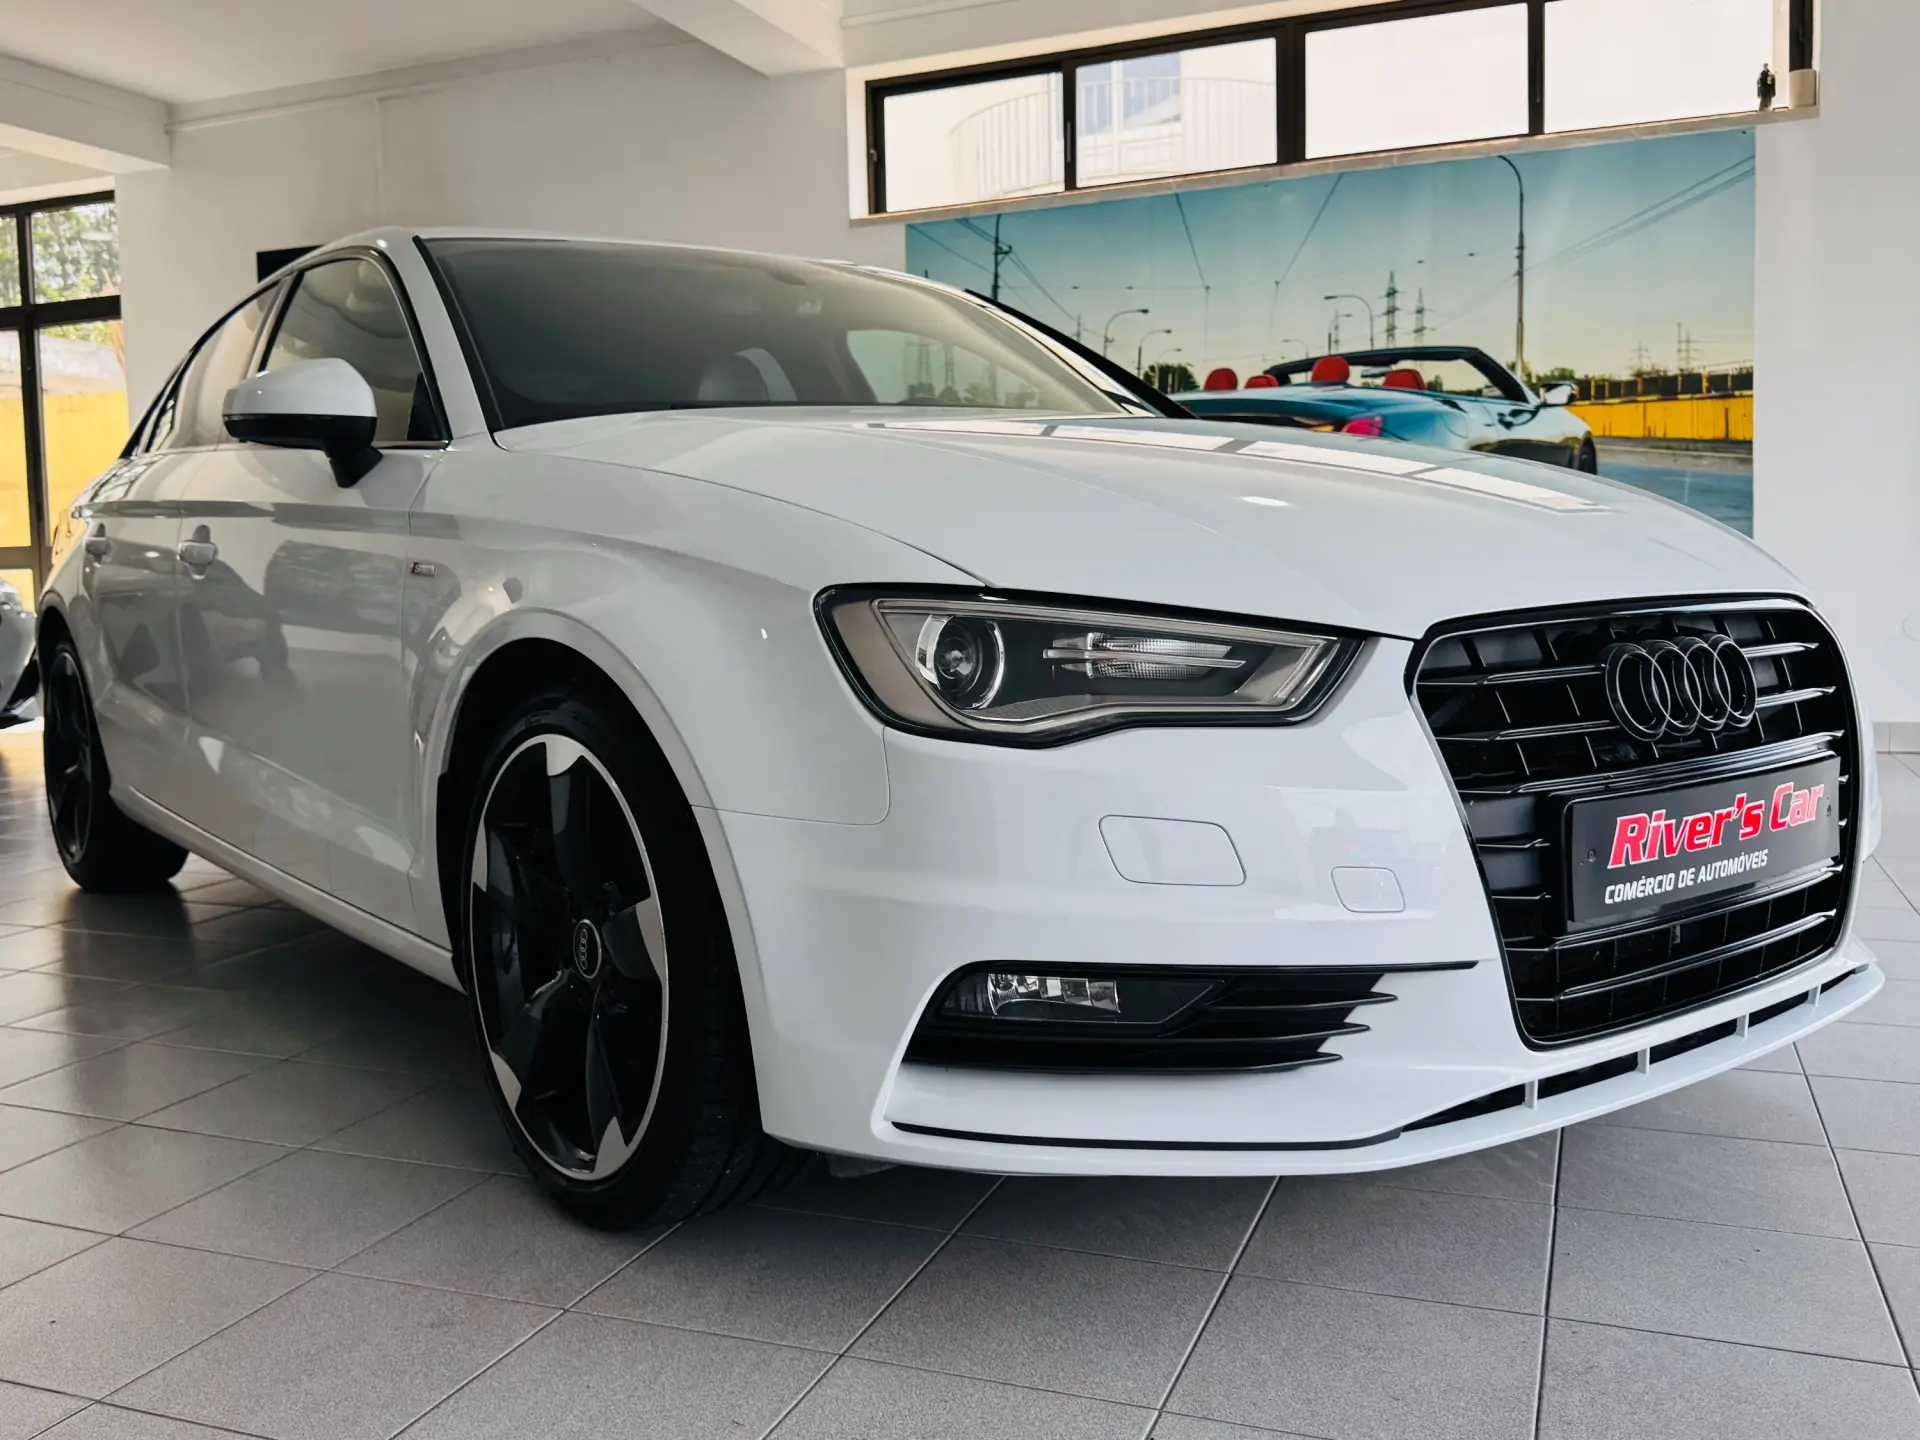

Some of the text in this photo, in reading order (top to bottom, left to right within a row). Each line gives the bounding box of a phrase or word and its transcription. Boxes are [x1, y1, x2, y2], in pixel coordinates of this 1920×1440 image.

[1607, 782, 1824, 869] River's Car
[1605, 849, 1769, 904] COMÉRCIO DE AUTOMÓVEIS
